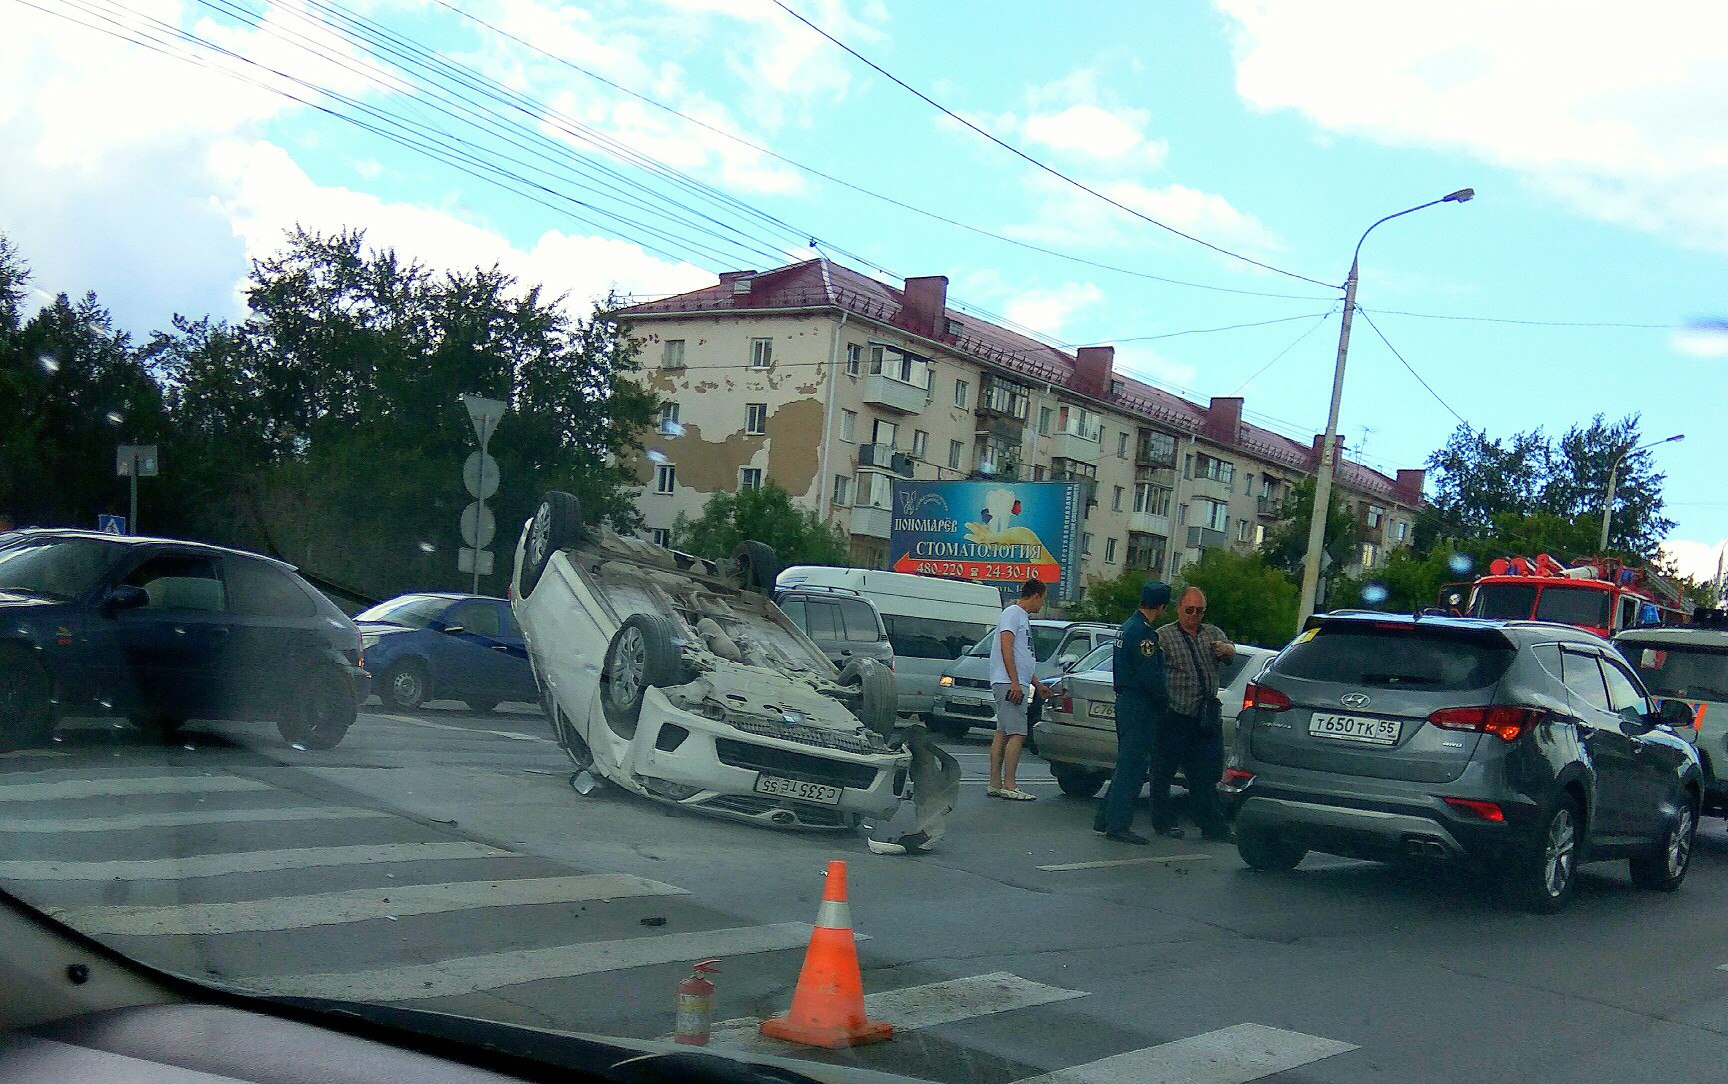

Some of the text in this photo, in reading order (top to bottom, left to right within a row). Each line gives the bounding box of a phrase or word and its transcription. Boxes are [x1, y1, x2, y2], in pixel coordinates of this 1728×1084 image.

[895, 517, 957, 533] ПОНОМАРЁВ
[916, 541, 1042, 560] СТОМАТОЛОГИЯ
[916, 562, 1039, 579] 480-220 24-30-16
